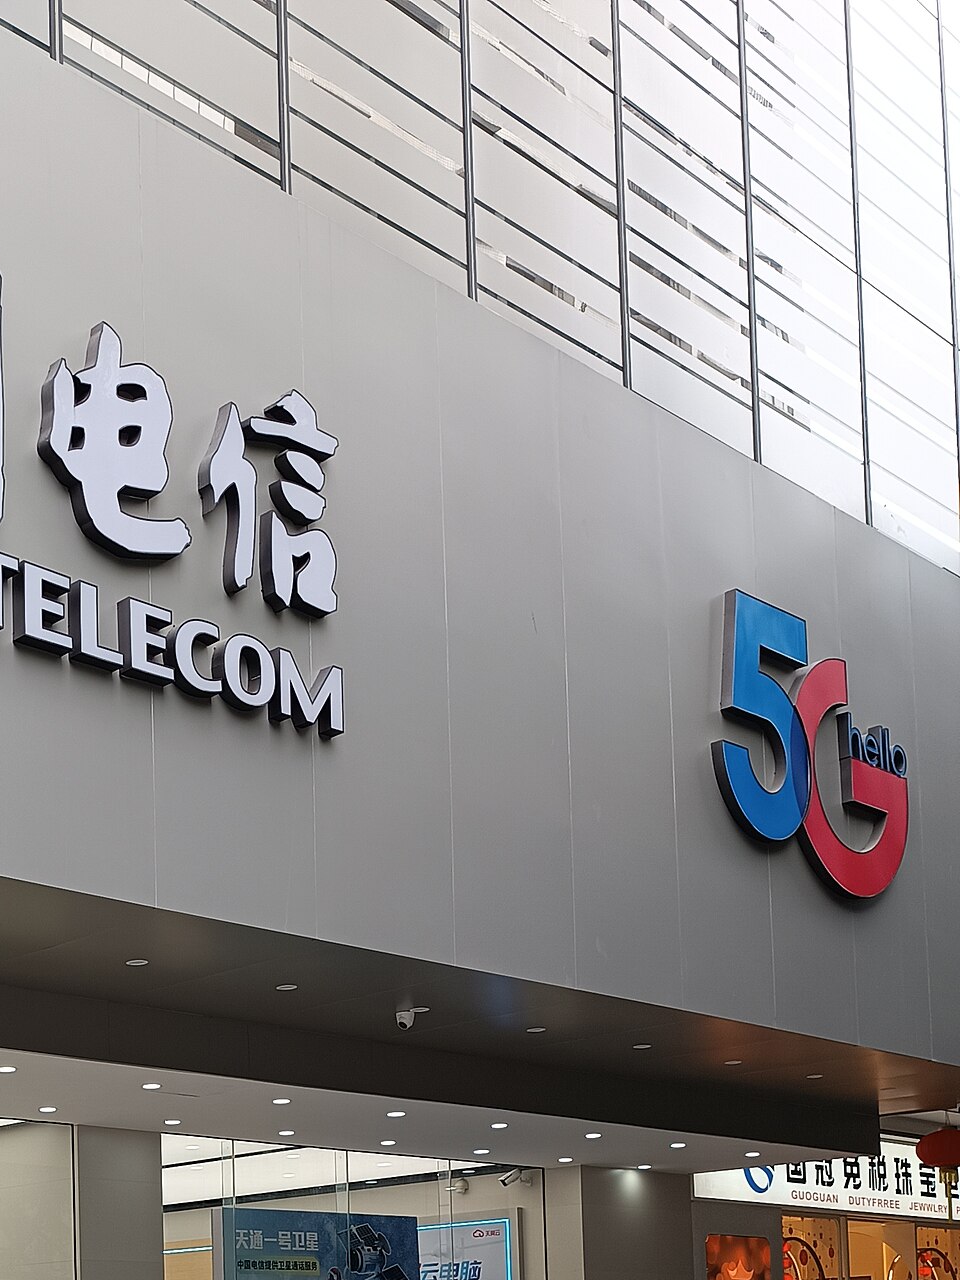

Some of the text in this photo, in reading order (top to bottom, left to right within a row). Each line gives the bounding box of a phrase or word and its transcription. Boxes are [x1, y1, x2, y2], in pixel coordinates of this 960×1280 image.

[711, 587, 908, 898] 5G
[837, 711, 907, 777] hello
[791, 1191, 839, 1204] GUOGUAN
[848, 1196, 900, 1209] DUTYFRREE
[235, 1229, 319, 1251] 天通一号卫星
